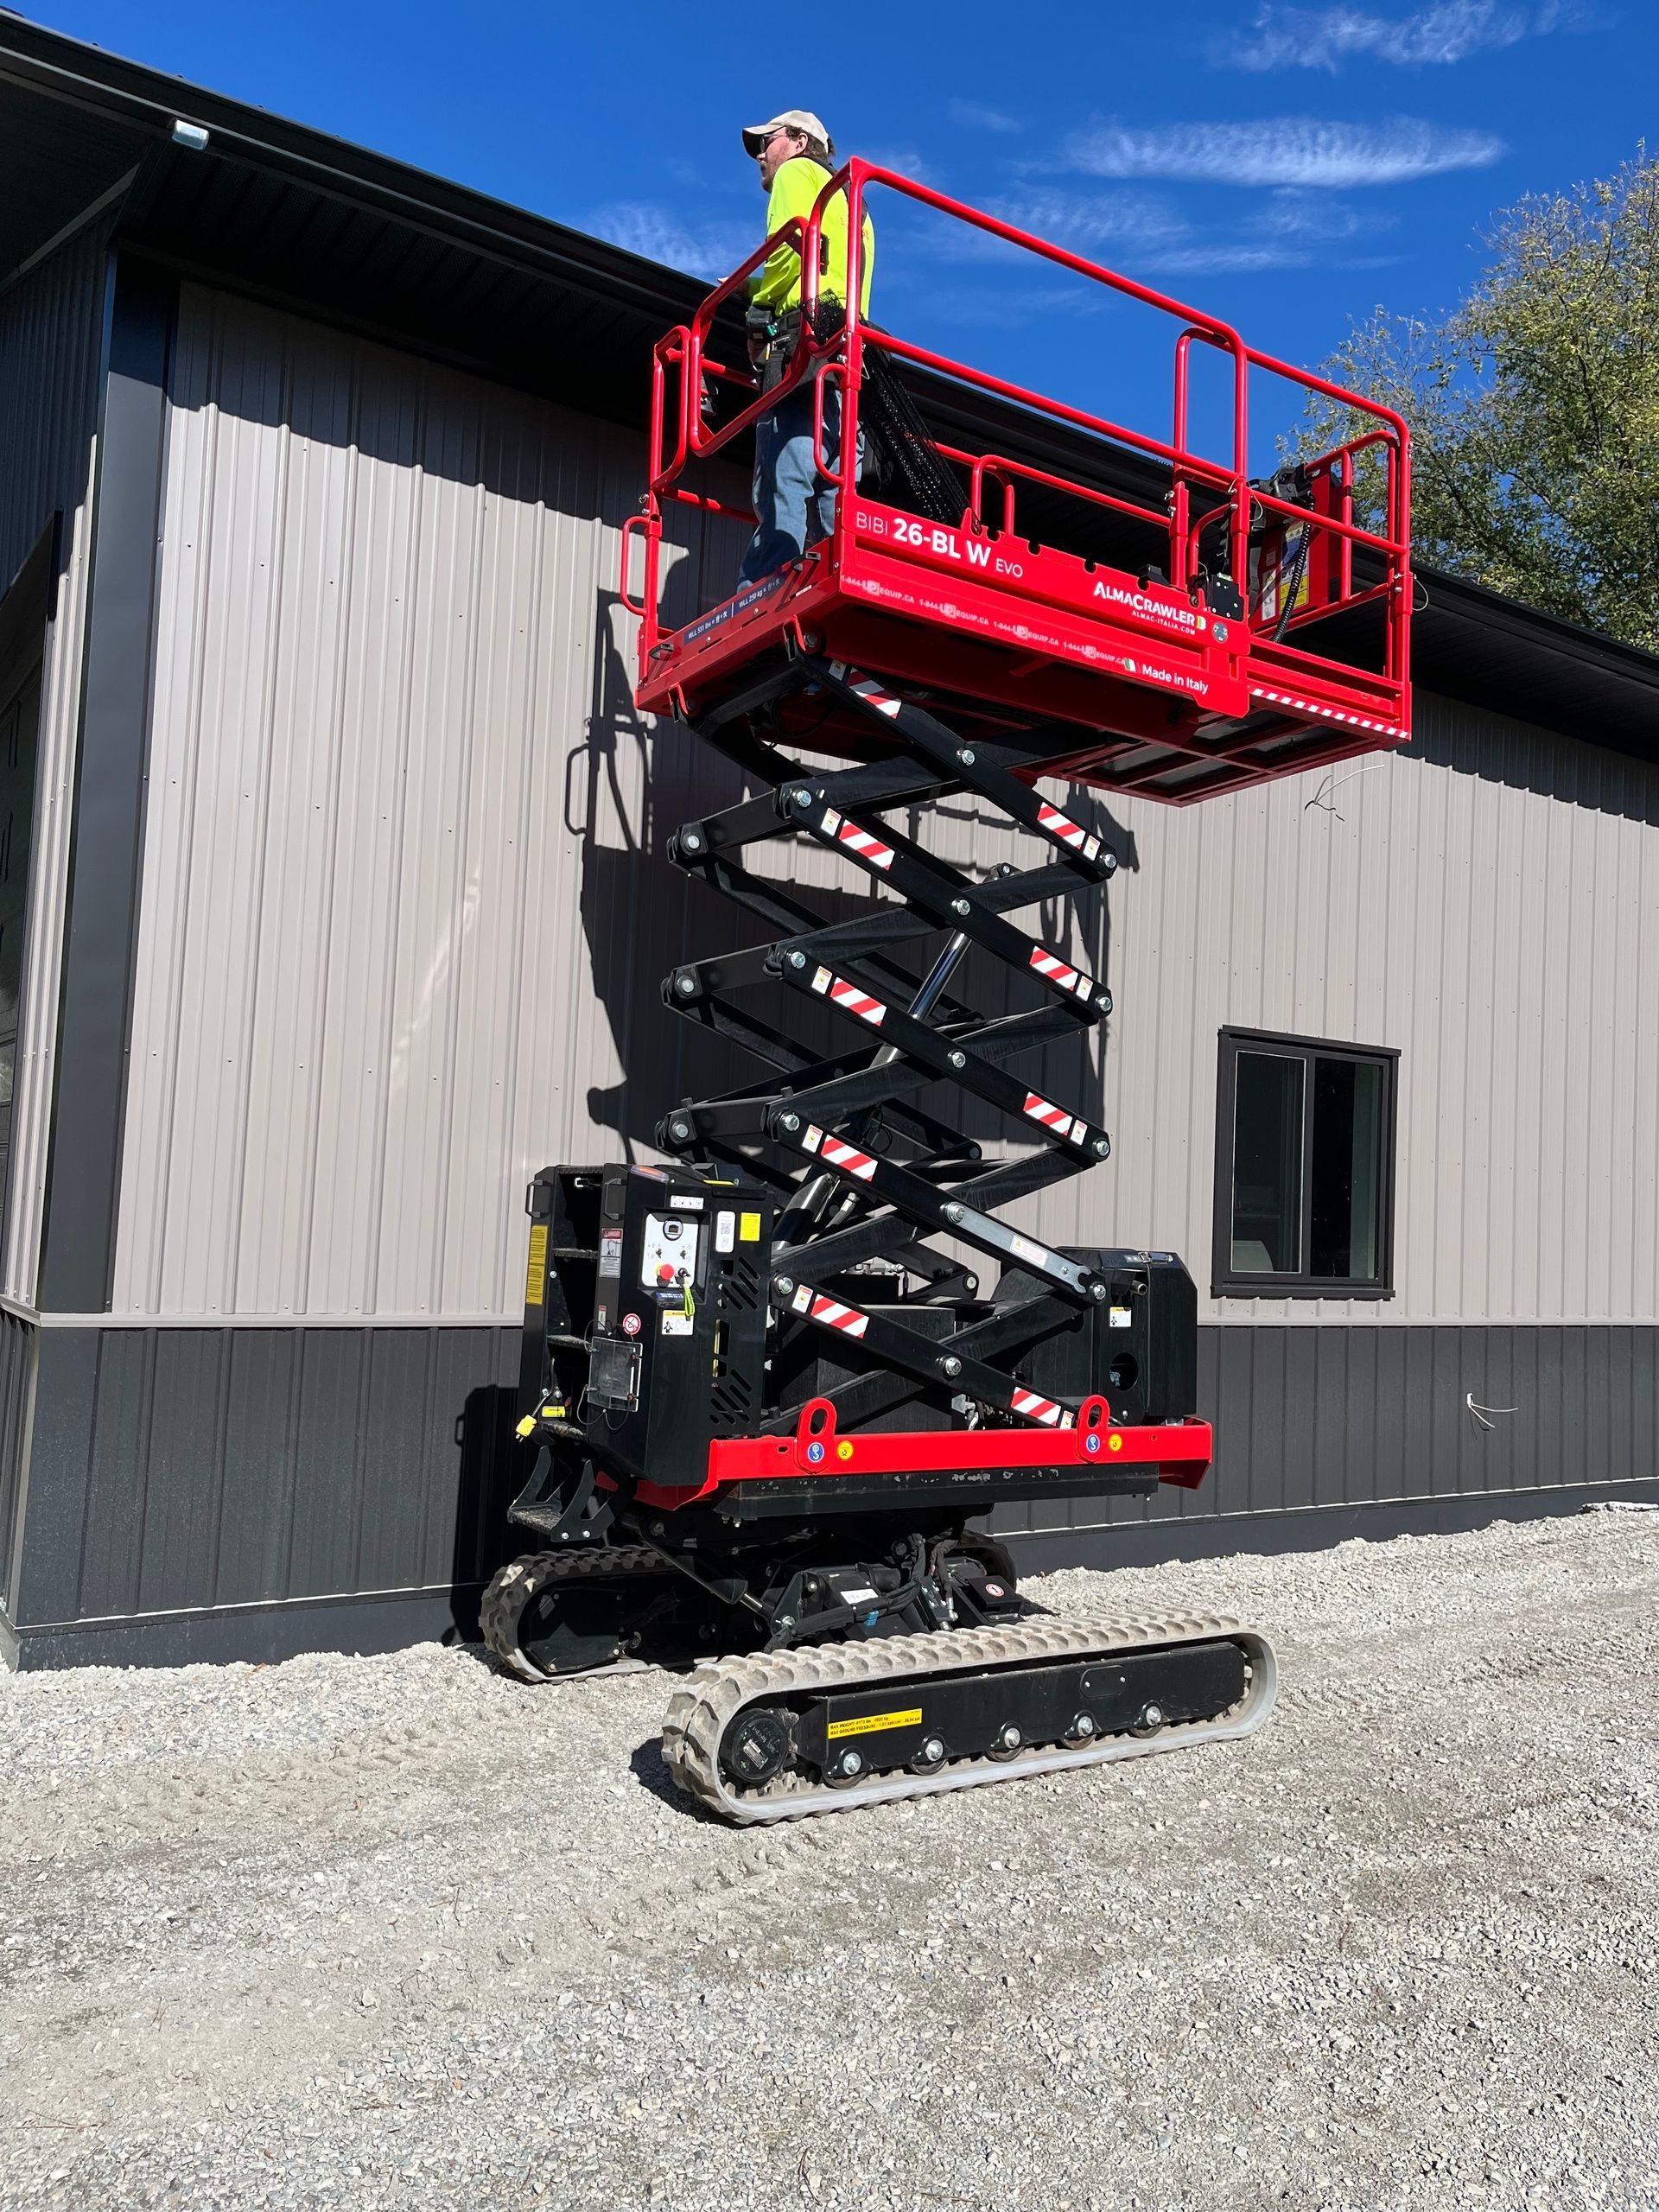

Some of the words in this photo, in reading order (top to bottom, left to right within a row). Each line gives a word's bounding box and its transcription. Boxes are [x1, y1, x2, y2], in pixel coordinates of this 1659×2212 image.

[856, 512, 888, 536] BIBI
[893, 518, 962, 559] 26-BL
[966, 540, 992, 567] W
[995, 558, 1024, 578] EVO
[1132, 610, 1196, 636] ALMAC-ITALIA.COM
[1142, 664, 1172, 683] Made
[1173, 673, 1184, 686] in
[1186, 677, 1209, 696] Italy
